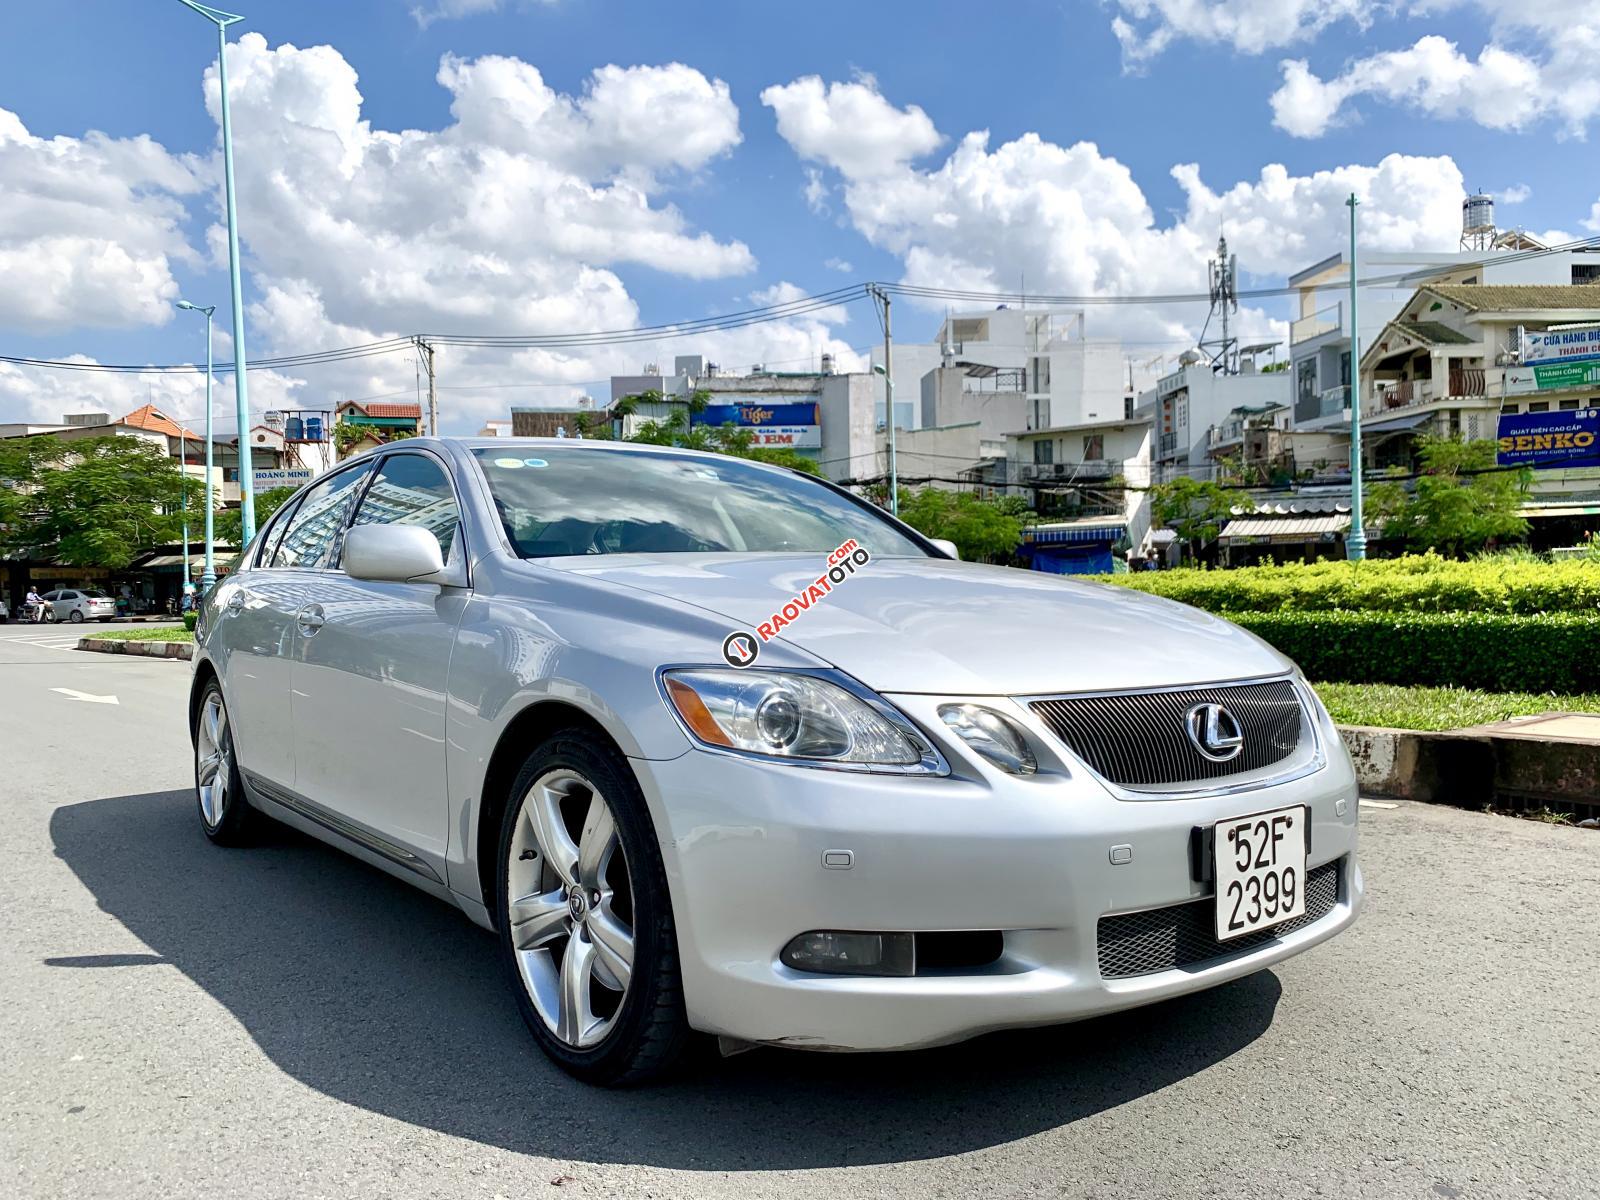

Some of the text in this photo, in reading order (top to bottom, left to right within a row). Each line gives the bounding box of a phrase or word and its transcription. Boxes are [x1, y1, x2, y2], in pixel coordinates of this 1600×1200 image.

[741, 407, 774, 424] Tiger
[1500, 432, 1595, 452] SENKO
[1235, 815, 1288, 873] 52F
[1227, 866, 1296, 932] 2399
